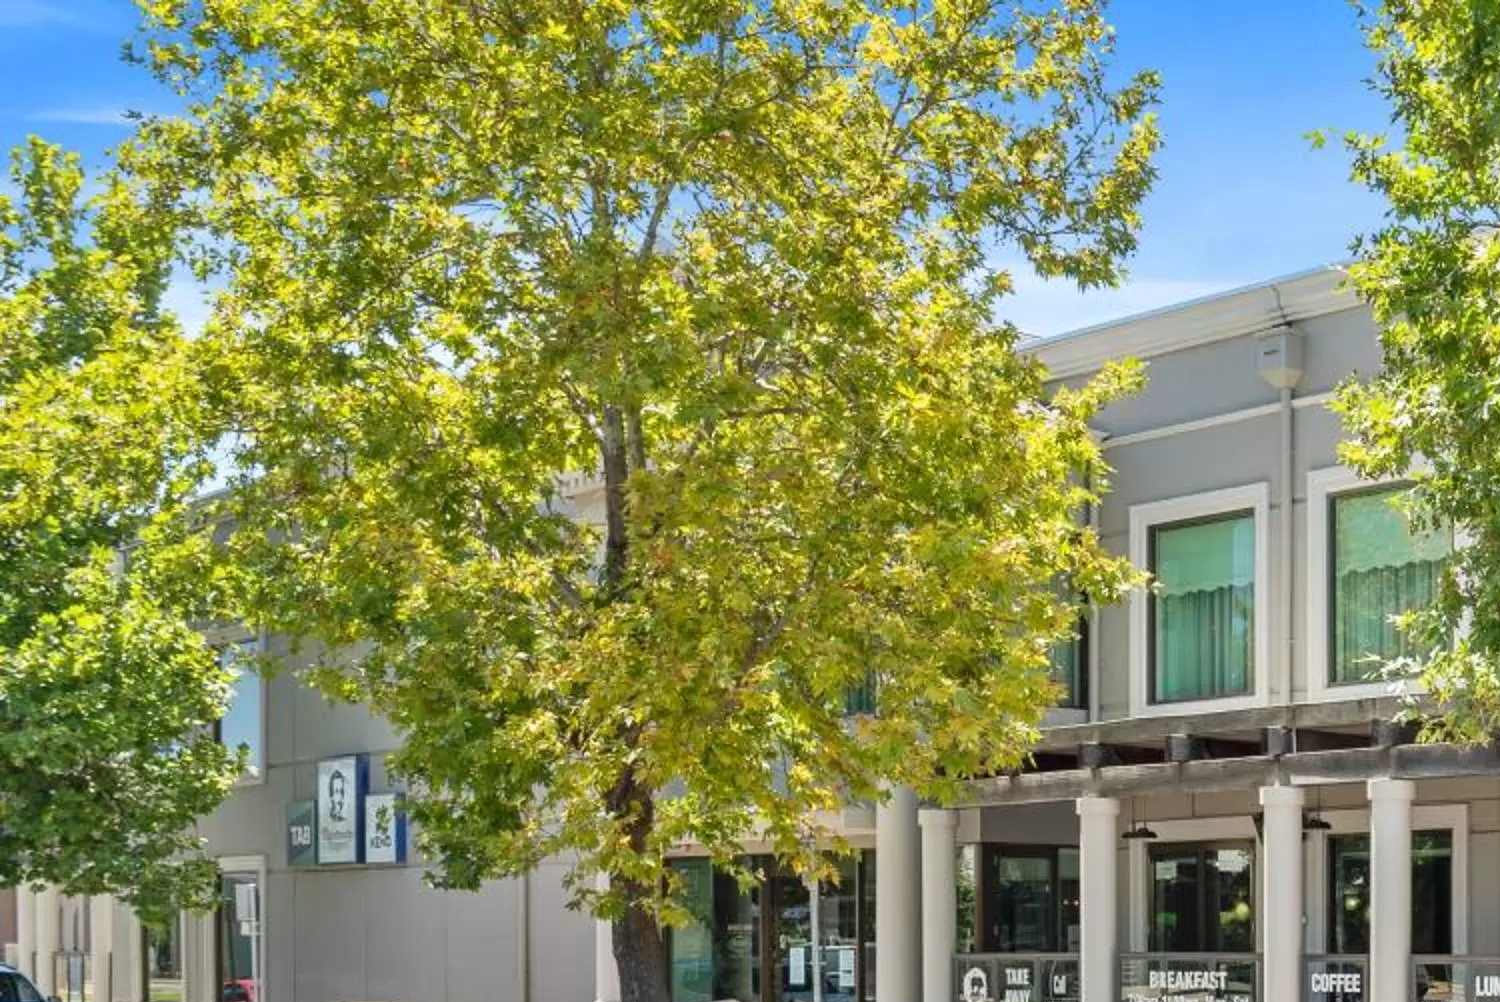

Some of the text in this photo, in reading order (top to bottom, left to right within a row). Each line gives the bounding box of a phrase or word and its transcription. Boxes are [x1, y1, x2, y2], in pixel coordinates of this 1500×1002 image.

[290, 825, 311, 847] TAB
[1005, 968, 1029, 985] TAKE
[1149, 971, 1228, 990] BREAKFAST
[1311, 973, 1361, 993] COFFEE
